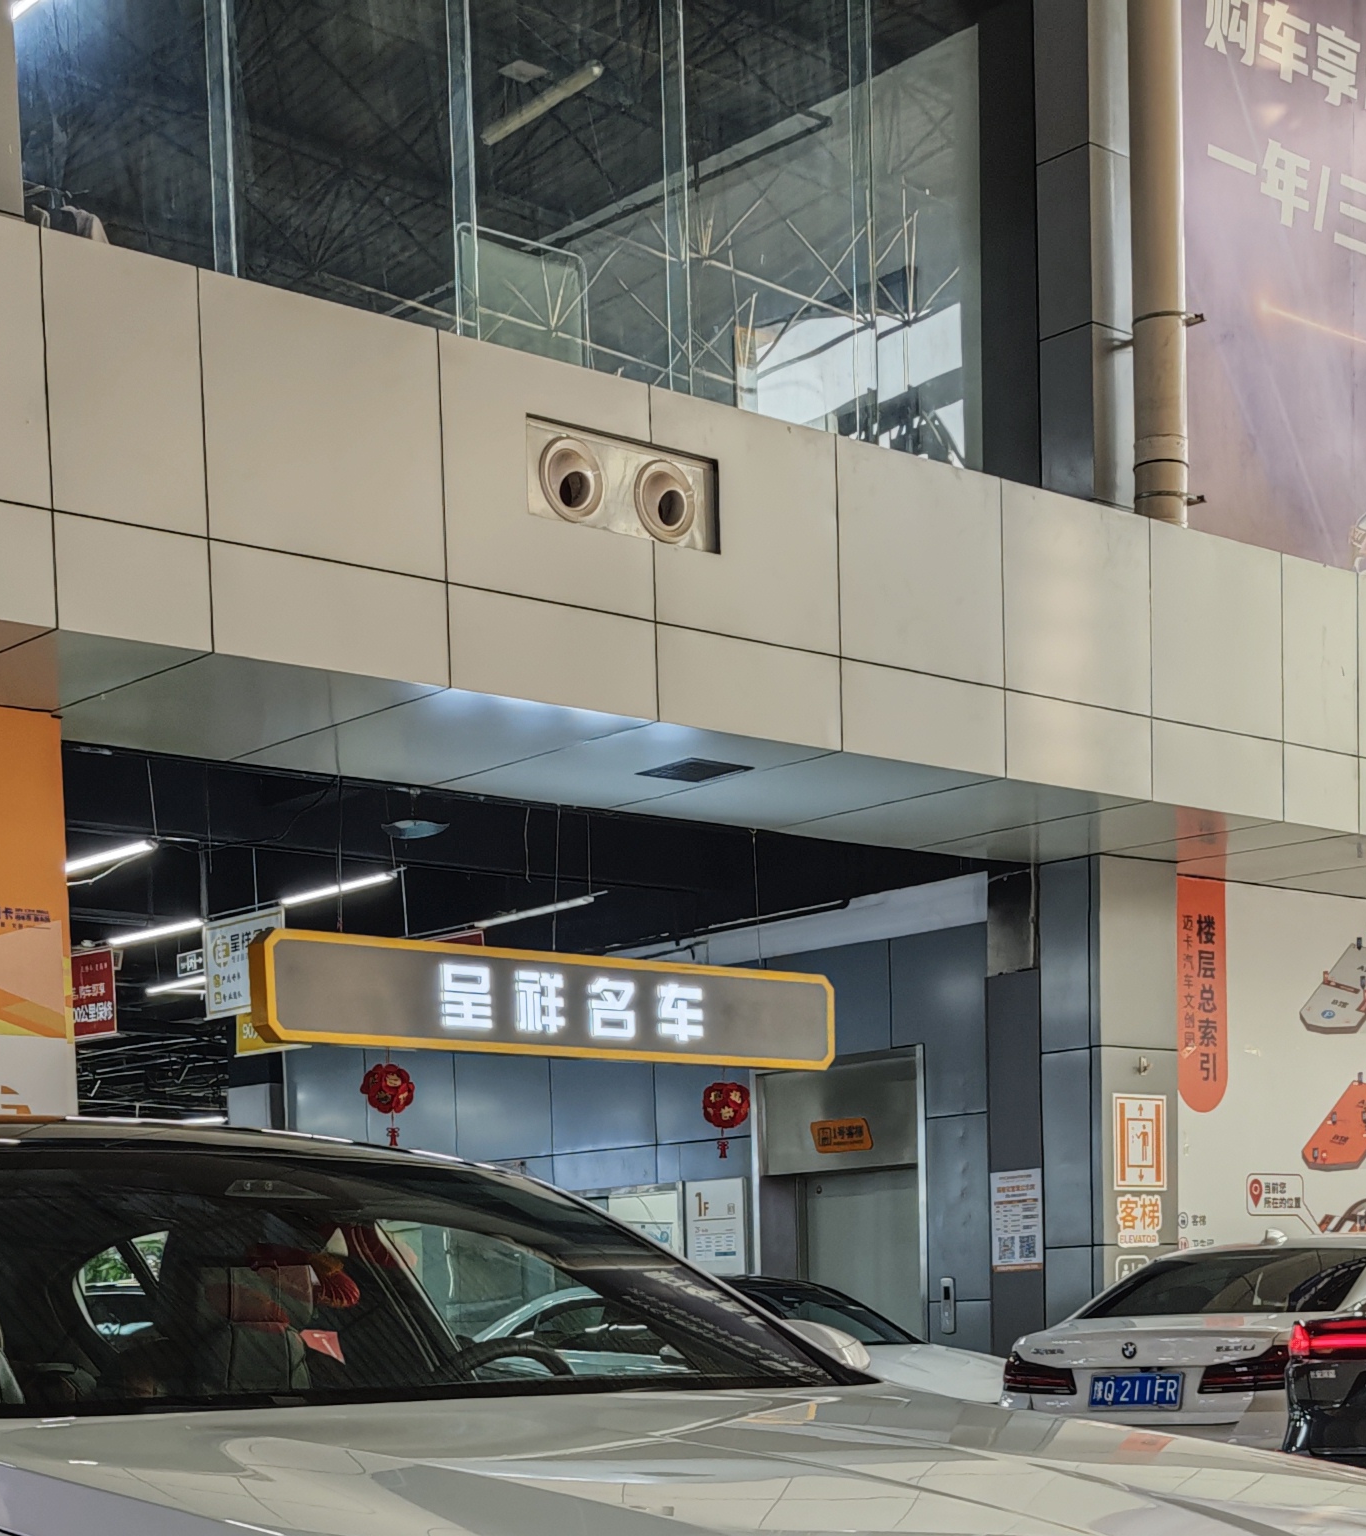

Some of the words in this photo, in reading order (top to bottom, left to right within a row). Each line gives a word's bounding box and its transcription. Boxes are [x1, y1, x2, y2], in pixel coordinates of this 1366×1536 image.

[439, 962, 705, 1043] 呈祥名车
[1196, 913, 1218, 1082] 楼层总索引
[695, 1192, 709, 1217] 1F
[1119, 1197, 1160, 1230] 客梯
[1119, 1233, 1158, 1245] ELEVATOR
